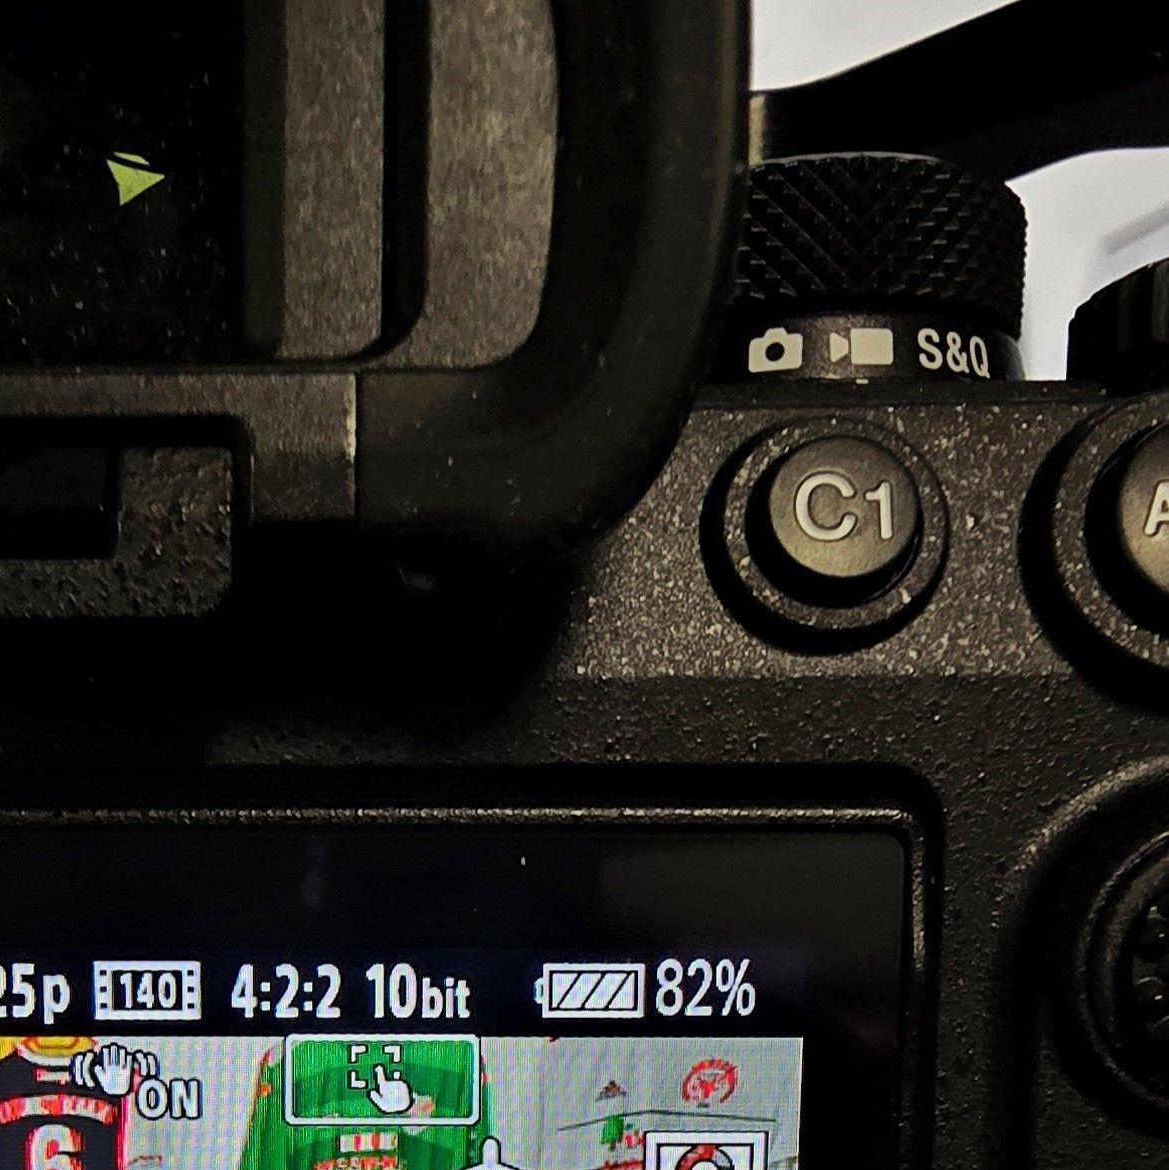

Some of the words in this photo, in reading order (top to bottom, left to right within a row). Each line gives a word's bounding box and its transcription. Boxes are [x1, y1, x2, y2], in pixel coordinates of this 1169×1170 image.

[918, 328, 992, 379] S&Q
[795, 472, 894, 542] C1
[120, 974, 177, 1007] 140
[231, 964, 341, 1018] 4:2:2
[366, 963, 470, 1018] 10bit
[655, 959, 756, 1017] 82%
[138, 1080, 200, 1118] ON
